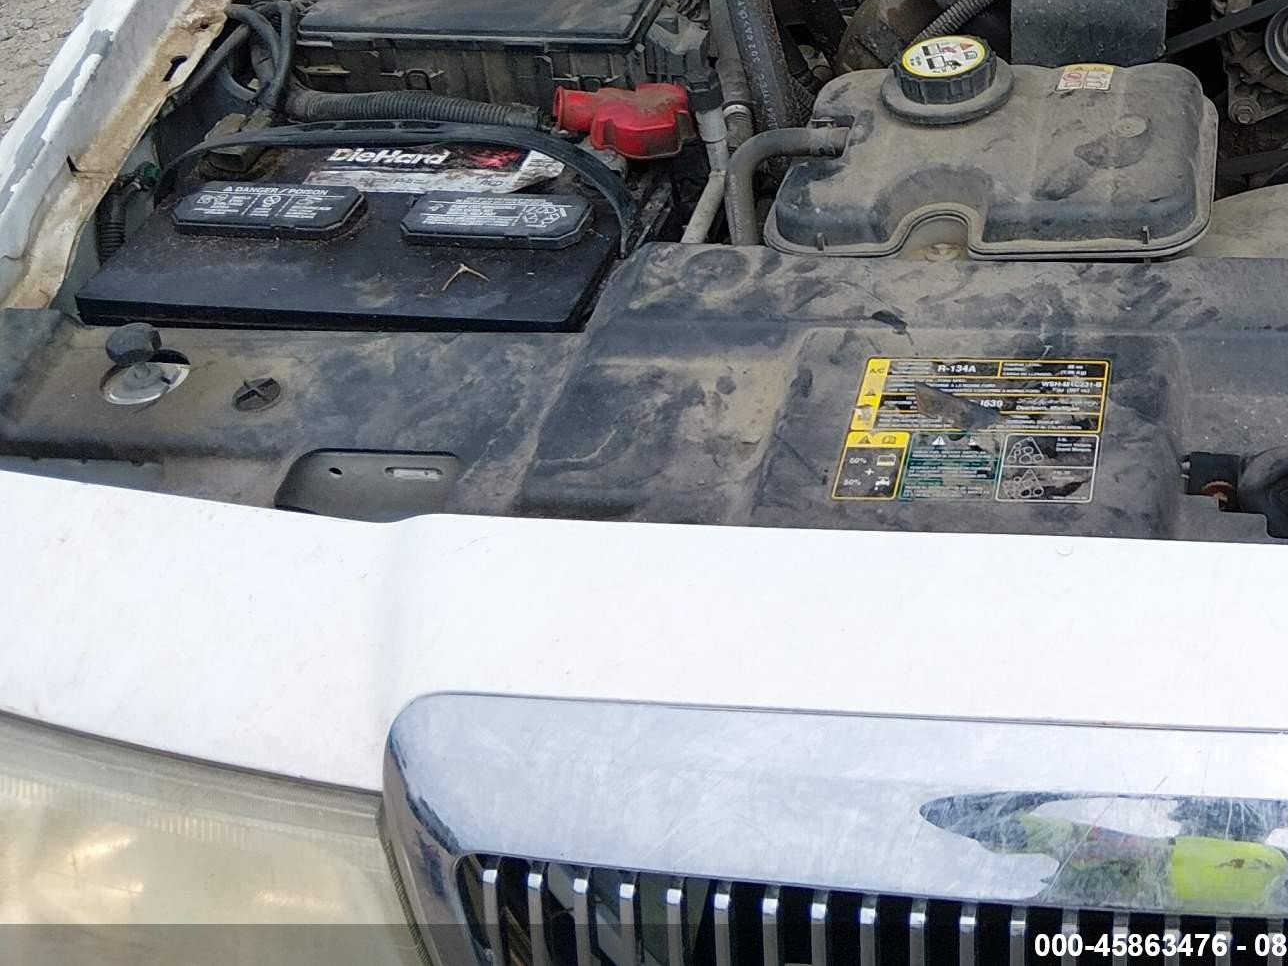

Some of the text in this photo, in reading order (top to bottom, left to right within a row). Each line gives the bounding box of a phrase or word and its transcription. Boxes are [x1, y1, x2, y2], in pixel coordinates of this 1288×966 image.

[327, 147, 450, 165] DieHard
[235, 186, 279, 194] DANGER
[289, 188, 329, 196] POISON
[937, 364, 977, 373] R-134A
[849, 456, 868, 465] 50%
[842, 478, 862, 486] 50%
